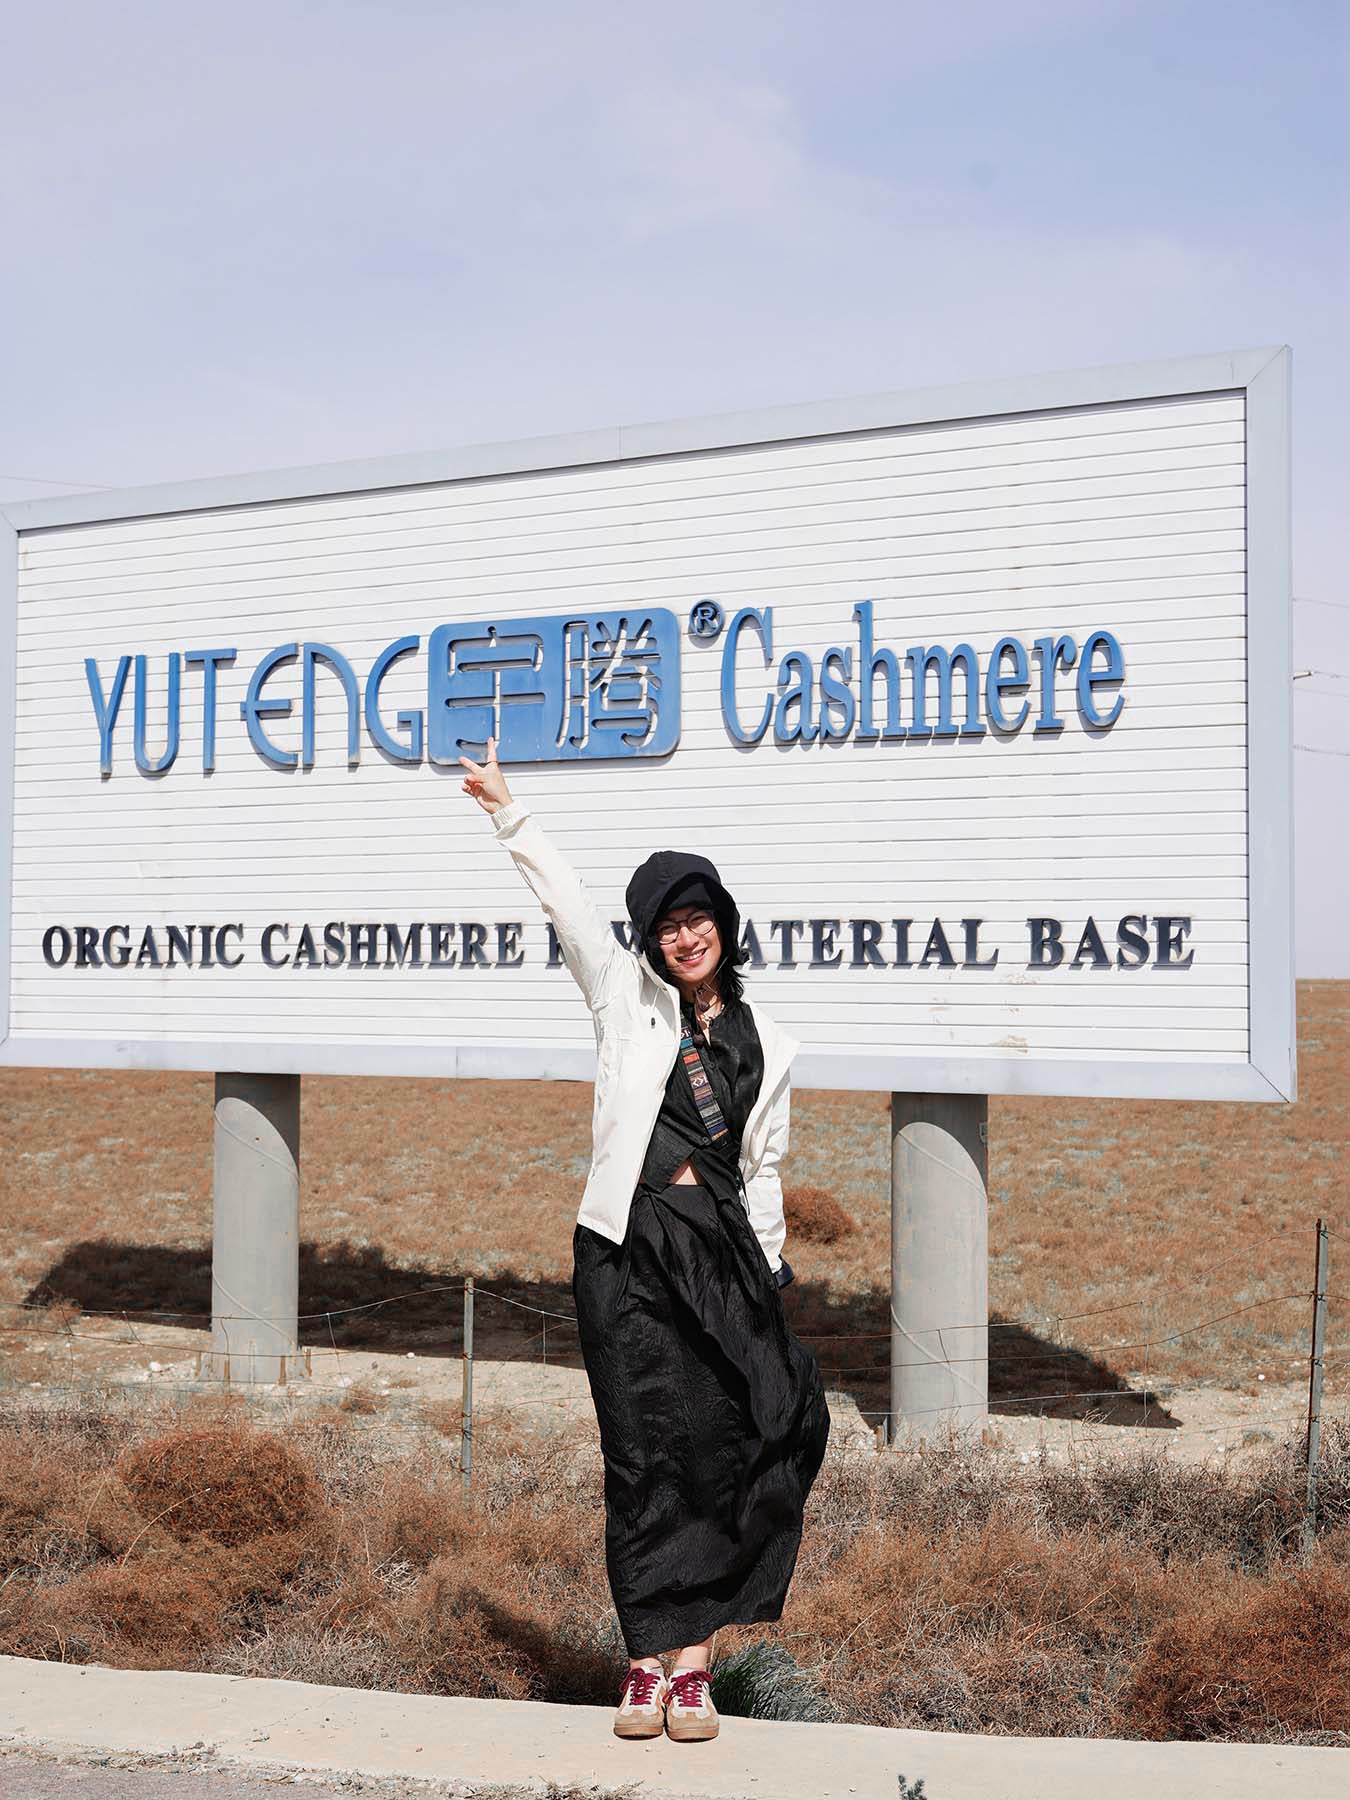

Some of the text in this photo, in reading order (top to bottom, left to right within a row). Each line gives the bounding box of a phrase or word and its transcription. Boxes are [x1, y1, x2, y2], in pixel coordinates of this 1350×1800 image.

[84, 635, 424, 774] YUTENG
[721, 600, 1126, 746] Cashmere
[43, 924, 245, 968] ORGANIC
[261, 922, 524, 969] CASHMERE
[738, 917, 999, 970] ATERIAL
[1026, 914, 1194, 970] BASE
